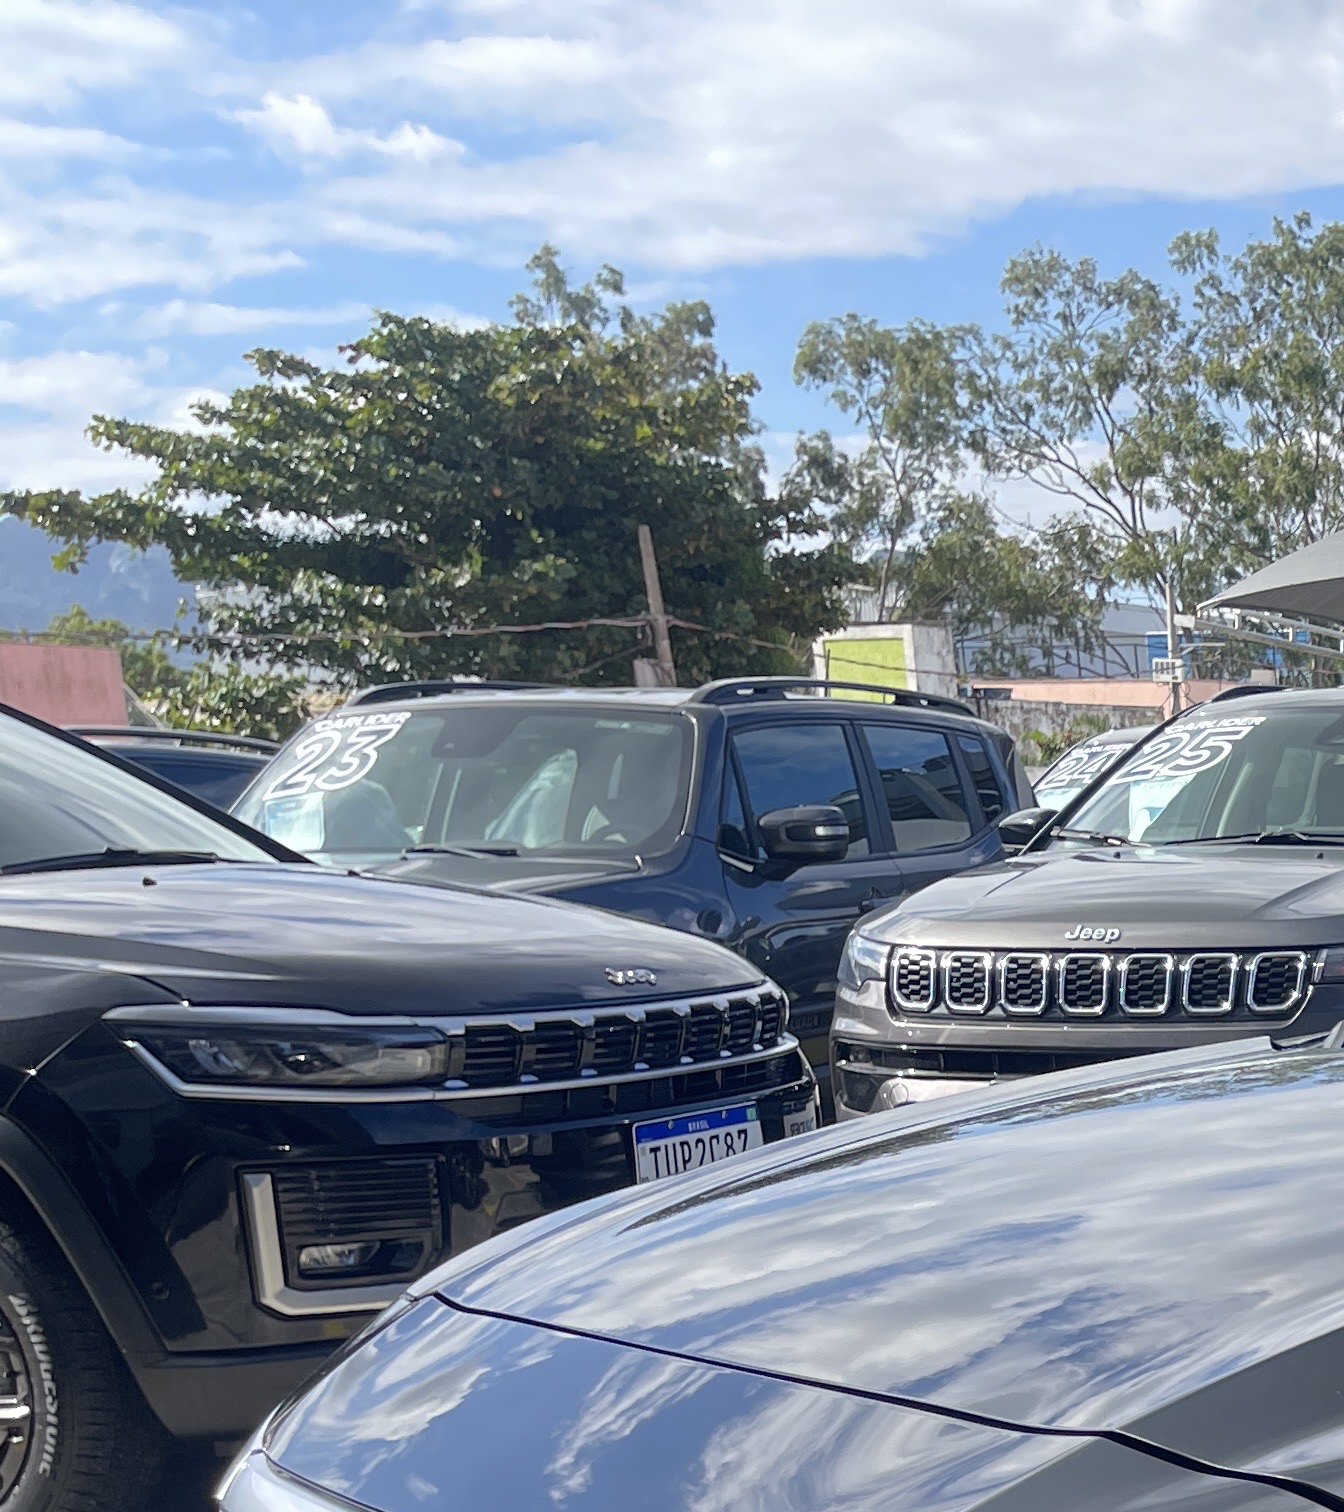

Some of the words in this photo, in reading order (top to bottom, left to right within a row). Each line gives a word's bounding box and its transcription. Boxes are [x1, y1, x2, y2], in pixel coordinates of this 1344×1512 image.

[1165, 716, 1267, 735] CARLIDER
[262, 723, 402, 801] 23
[1036, 749, 1123, 791] 24
[1105, 725, 1255, 787] 25
[1064, 923, 1120, 943] Jeep
[687, 1119, 710, 1133] BRASIL
